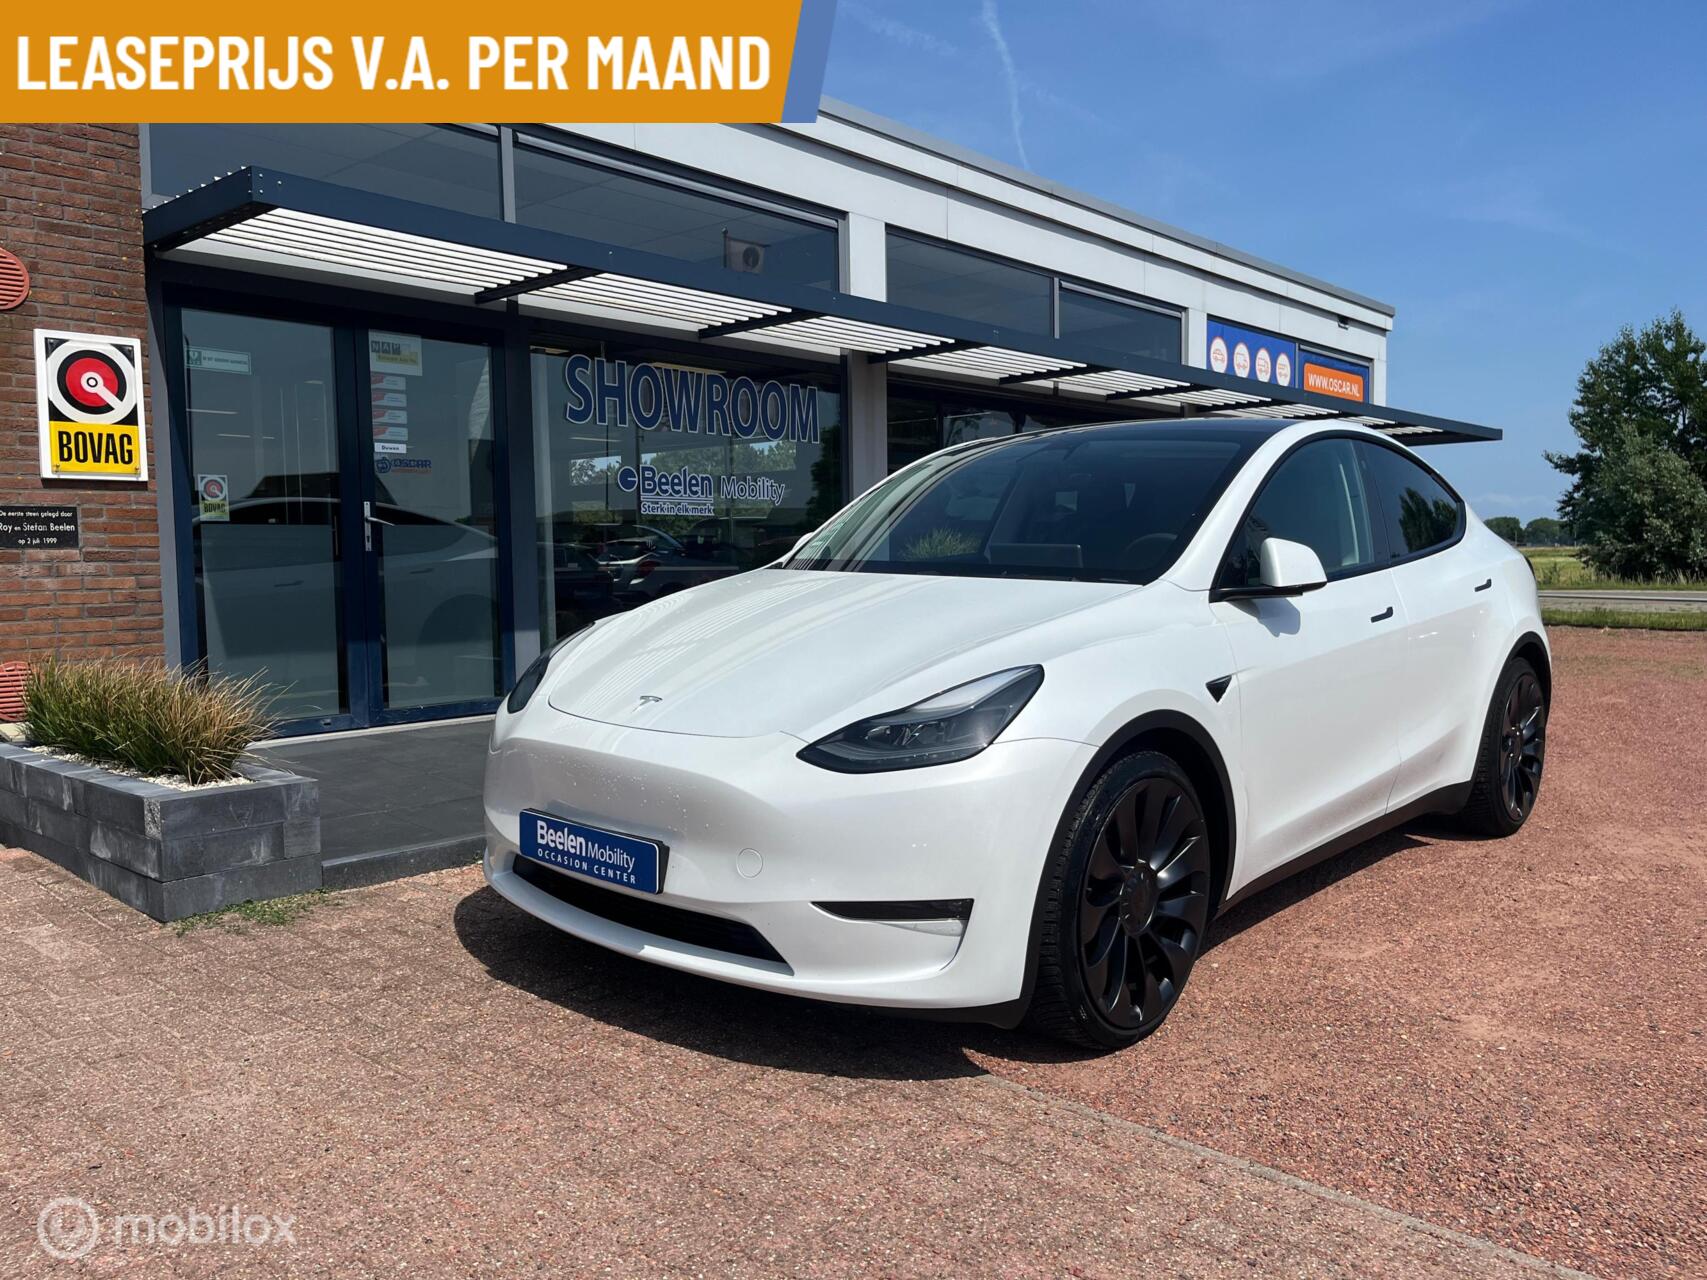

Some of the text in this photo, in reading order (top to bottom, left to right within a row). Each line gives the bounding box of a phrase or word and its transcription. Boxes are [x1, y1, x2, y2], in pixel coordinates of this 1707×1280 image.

[565, 354, 820, 444] SHOWROOM
[1307, 372, 1360, 397] WWW.OSCAR.NL
[58, 430, 133, 465] BOVAG
[640, 464, 785, 506] Beelen Mobility
[204, 503, 226, 513] BOVAG
[641, 502, 714, 515] Sterk in elk merk
[23, 522, 48, 531] Stefan
[50, 522, 75, 531] Beelen
[536, 820, 635, 873] Beelen Mobility
[538, 849, 636, 884] OCCASION CENTER
